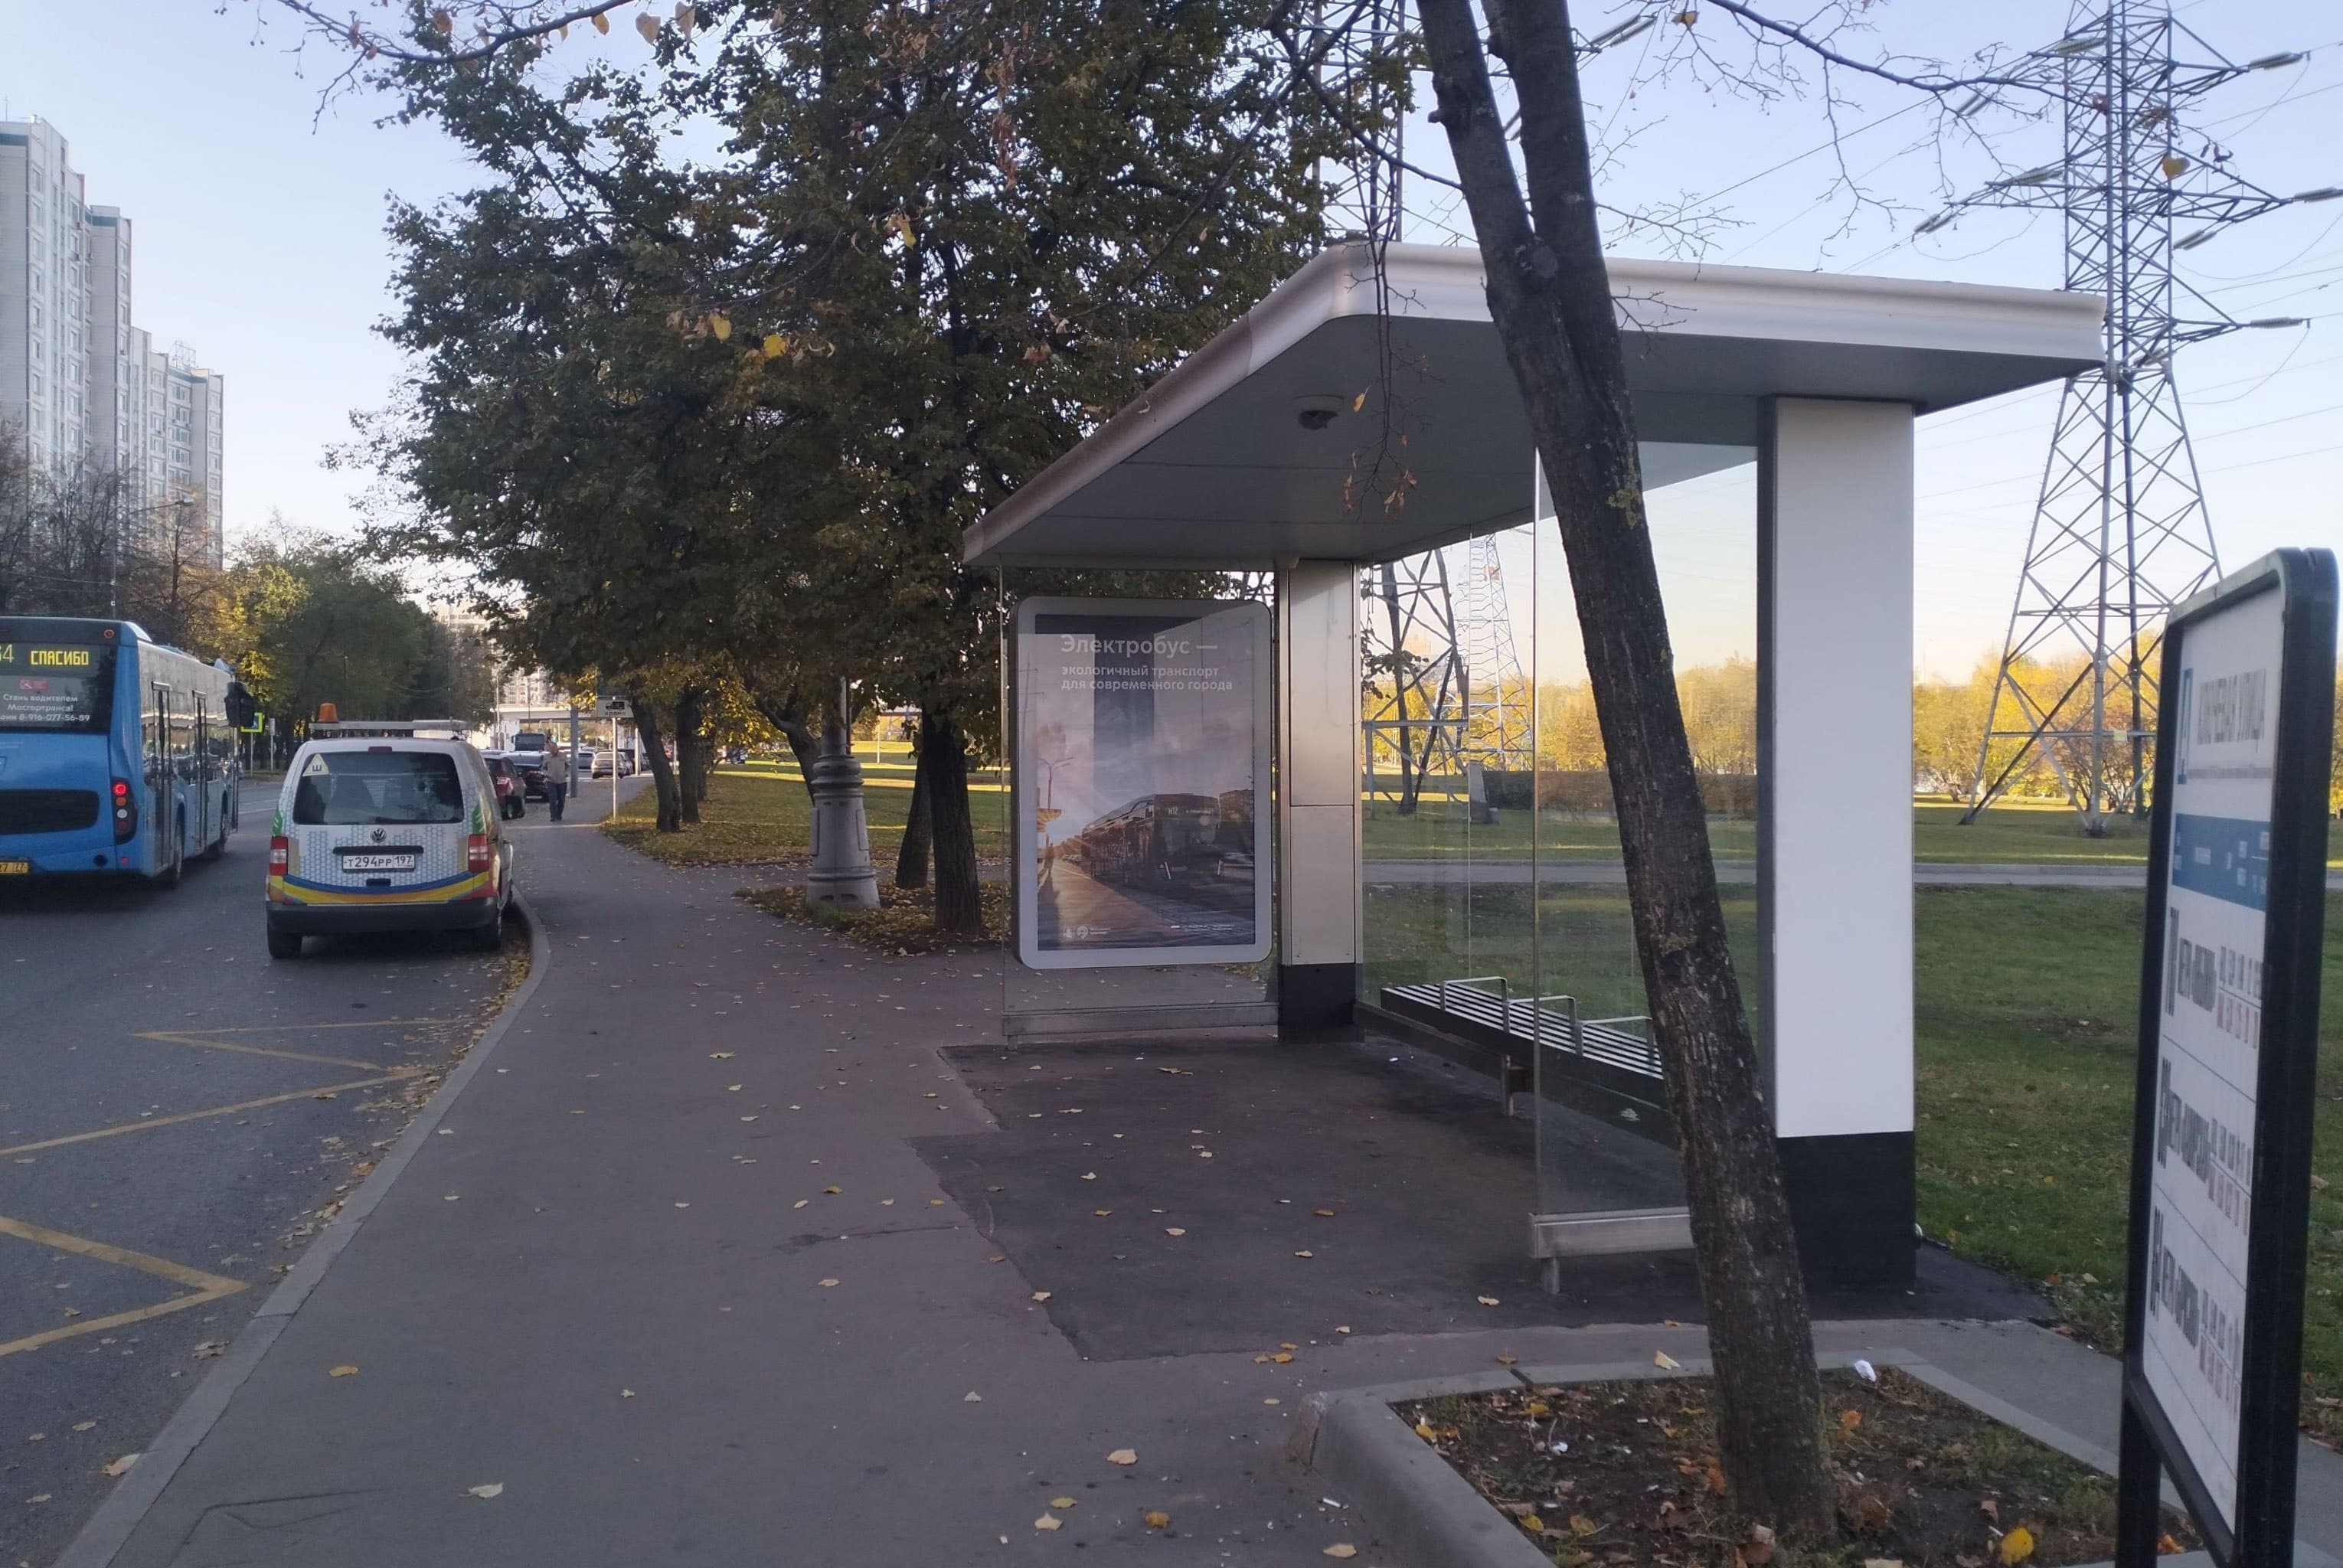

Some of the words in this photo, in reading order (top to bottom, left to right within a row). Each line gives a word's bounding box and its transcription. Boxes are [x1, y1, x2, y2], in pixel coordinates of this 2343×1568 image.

[1060, 634, 1190, 658] Электробус
[31, 651, 89, 665] СПАСИБО
[1060, 665, 1149, 677] экологичный
[1151, 666, 1220, 678] транспорт
[1060, 679, 1086, 691] для
[1089, 681, 1185, 693] современного
[1188, 681, 1234, 691] города
[30, 694, 79, 703] водителем
